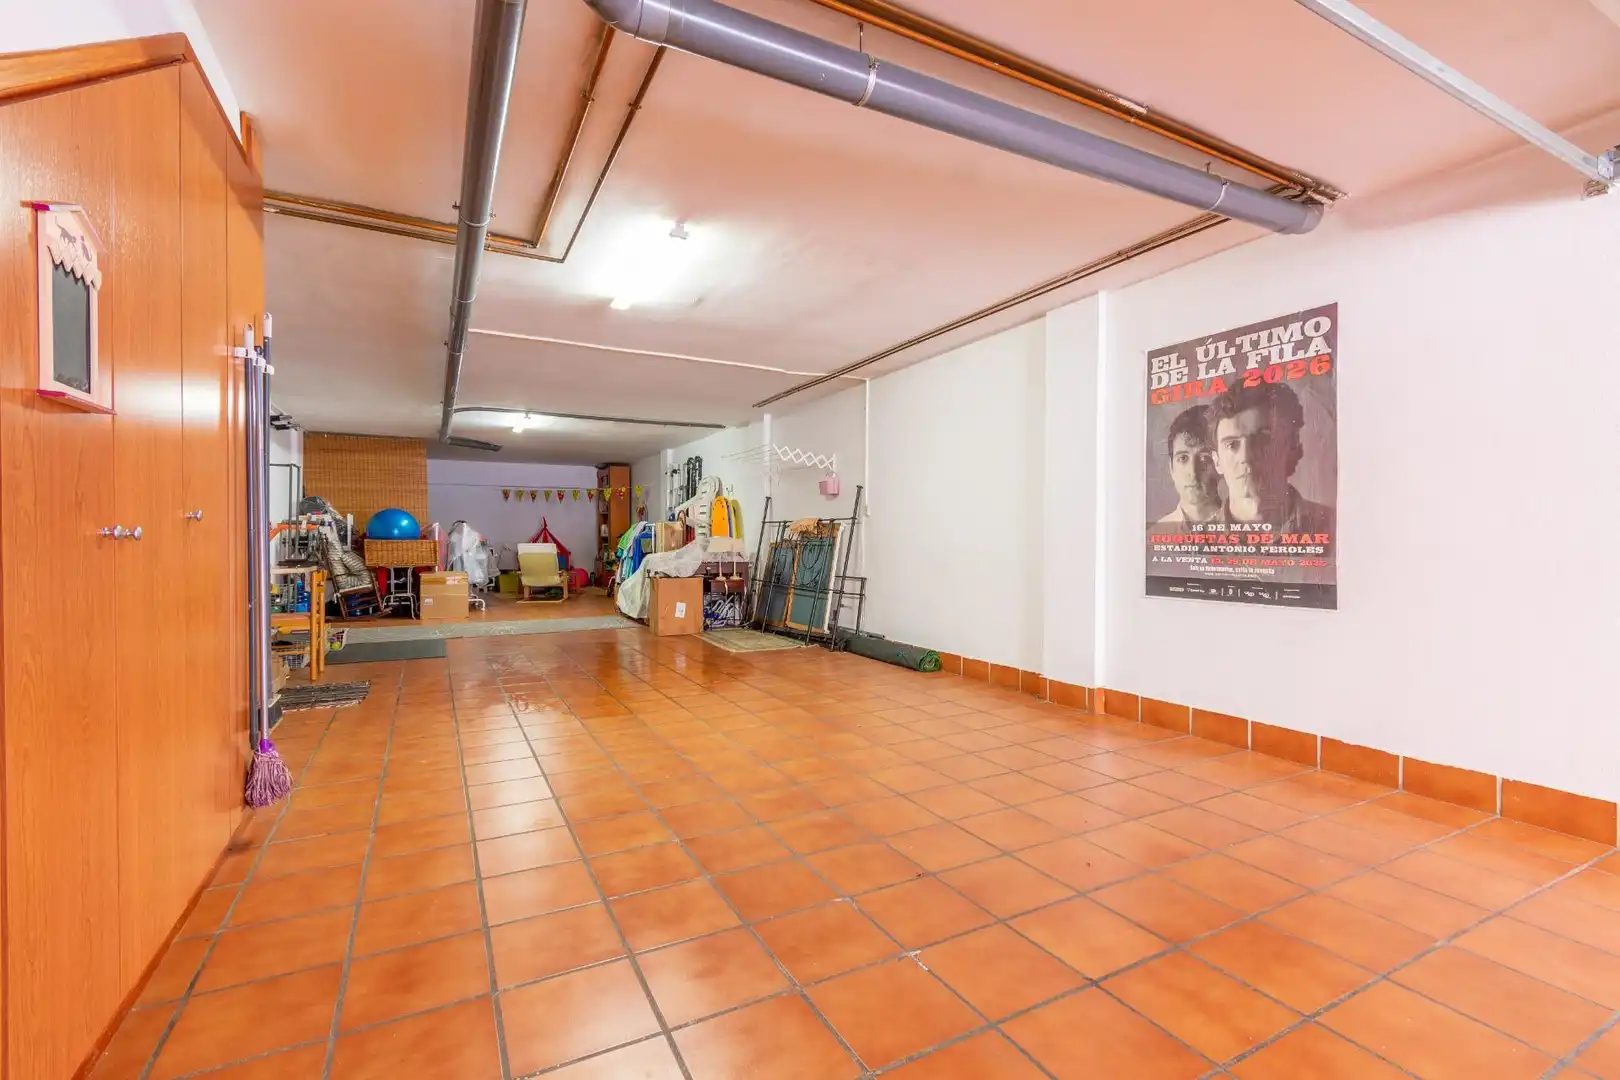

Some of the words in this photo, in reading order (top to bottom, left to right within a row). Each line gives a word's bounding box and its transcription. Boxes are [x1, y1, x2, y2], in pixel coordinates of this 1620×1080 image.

[1151, 352, 1186, 373] EL
[1195, 315, 1332, 362] ÚLTIMO
[1150, 367, 1189, 390] DE
[1197, 357, 1236, 380] LA
[1246, 336, 1332, 369] FILA
[1151, 378, 1228, 405] GIRA
[1241, 354, 1332, 388] 2026
[1151, 533, 1240, 545] ROQUETAS
[1246, 534, 1273, 544] DE
[1281, 533, 1330, 544] MAR
[1191, 524, 1204, 532] 16
[1208, 524, 1226, 532] DE
[1230, 523, 1272, 532] MAYO
[1203, 545, 1256, 553] ANTONIO
[1260, 545, 1324, 554] PEROLES
